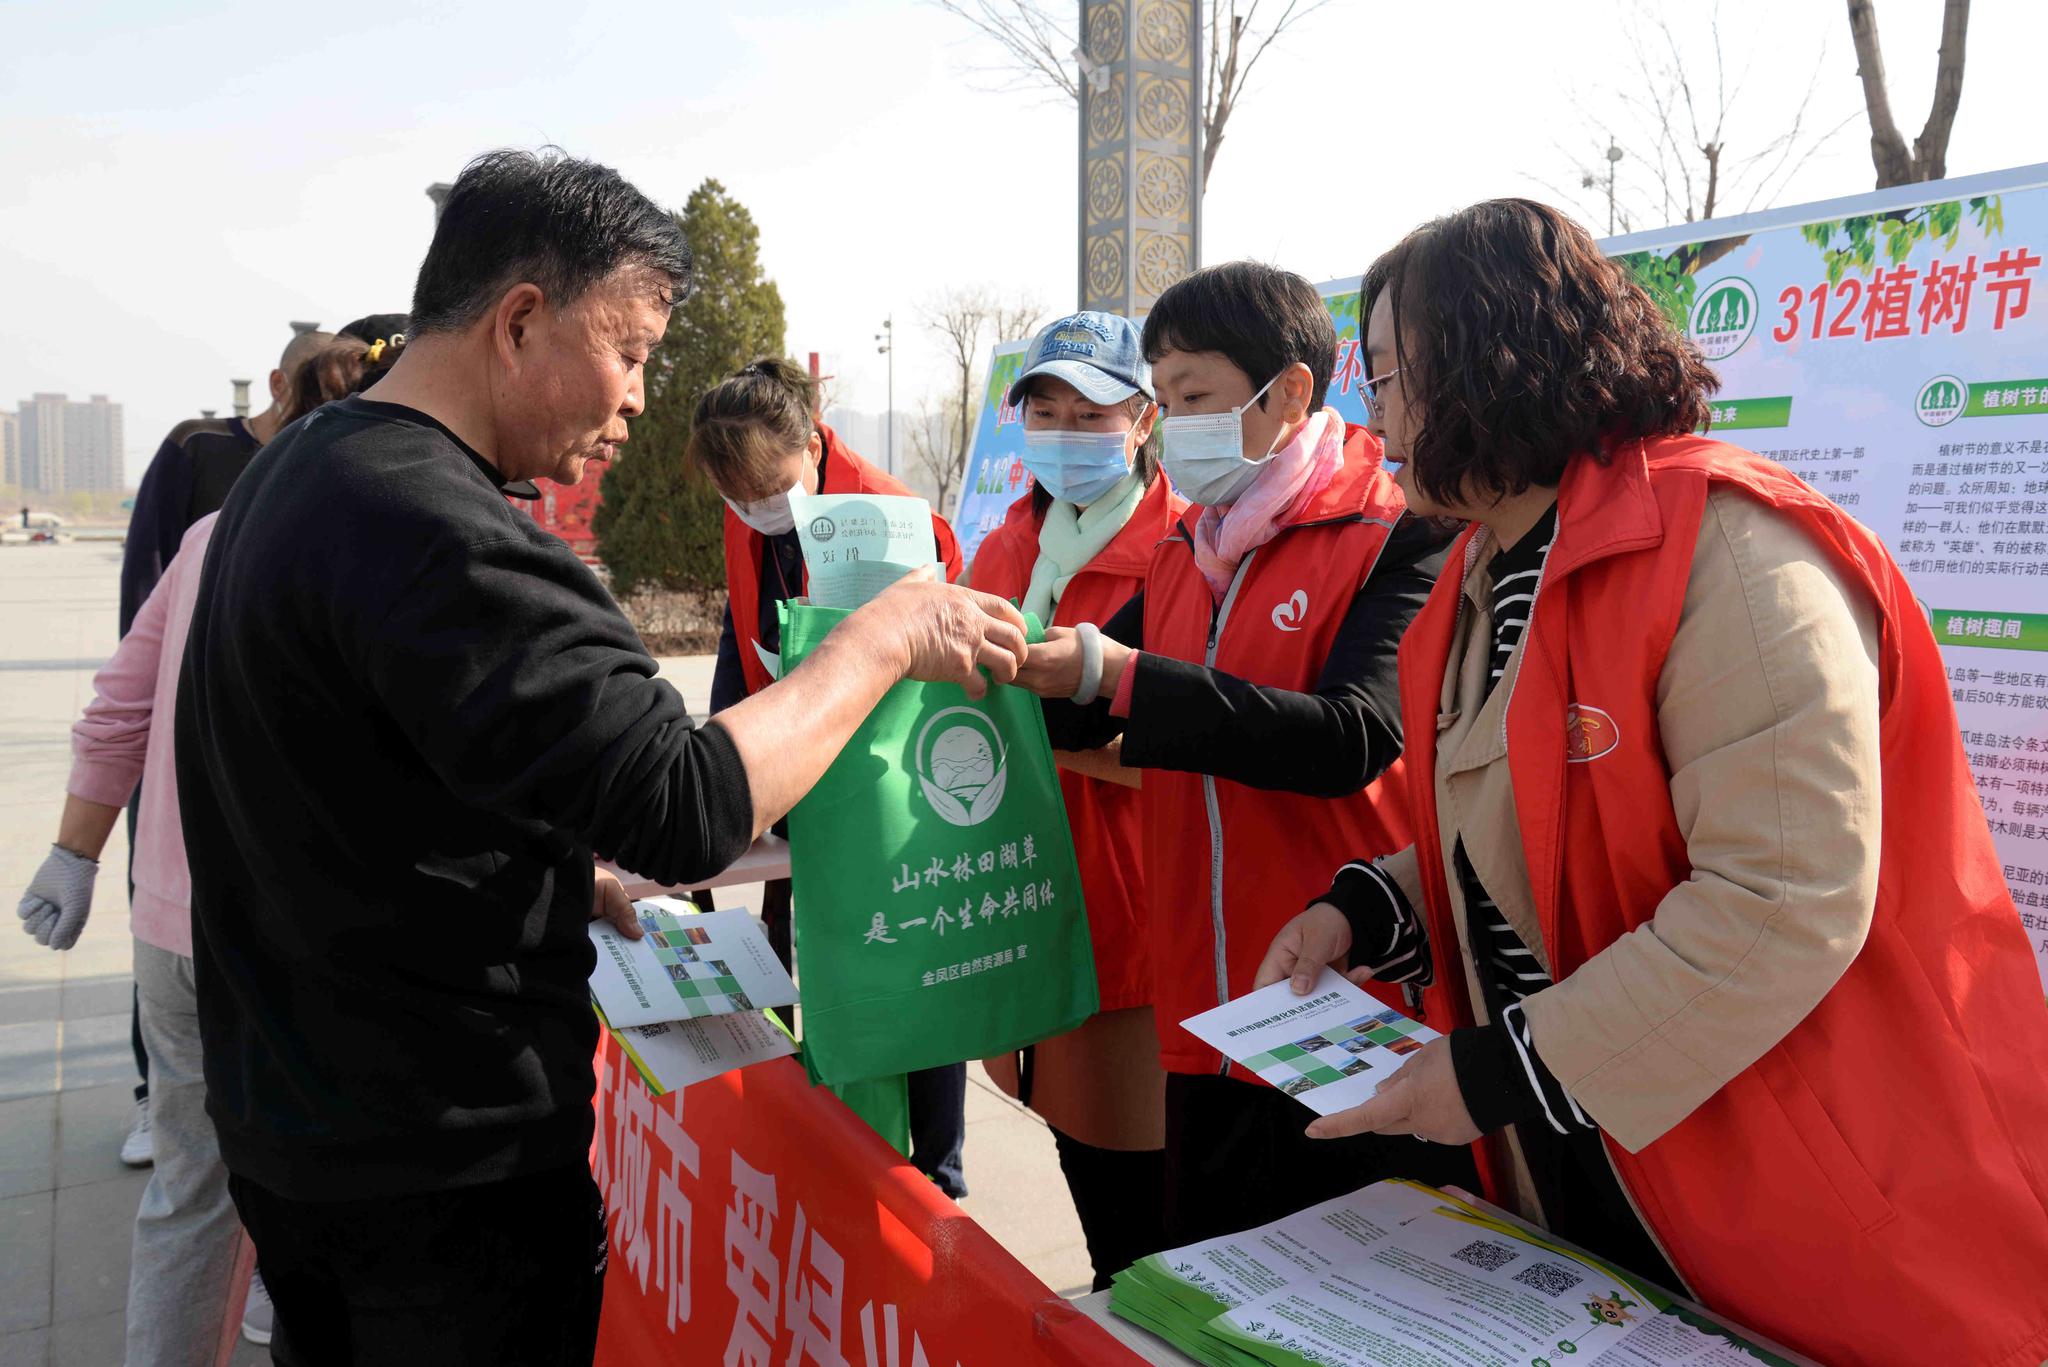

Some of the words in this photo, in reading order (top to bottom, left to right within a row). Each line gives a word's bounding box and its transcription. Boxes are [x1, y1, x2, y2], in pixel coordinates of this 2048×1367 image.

[1773, 248, 2041, 342] 312植树节
[1753, 447, 1865, 461] 了我国近代史上第一部
[1794, 469, 1859, 482] 每年“清明”
[1902, 520, 2048, 535] 样的一群人：他们在默默
[1900, 540, 2048, 556] 被称为“英雄”、有的被称
[1946, 616, 2022, 639] 植树趣闻
[1945, 667, 2048, 688] 岛等一些地区有
[1965, 751, 2048, 775] 结婚必须种树
[1972, 773, 2048, 797] 本有一项特
[892, 834, 1038, 894] 山水林田湖草
[2003, 865, 2048, 886] 尼亚的
[863, 878, 1055, 945] 是一个生命共同体
[922, 948, 1013, 987] 金凤区自然资源局
[1017, 945, 1028, 959] 宣
